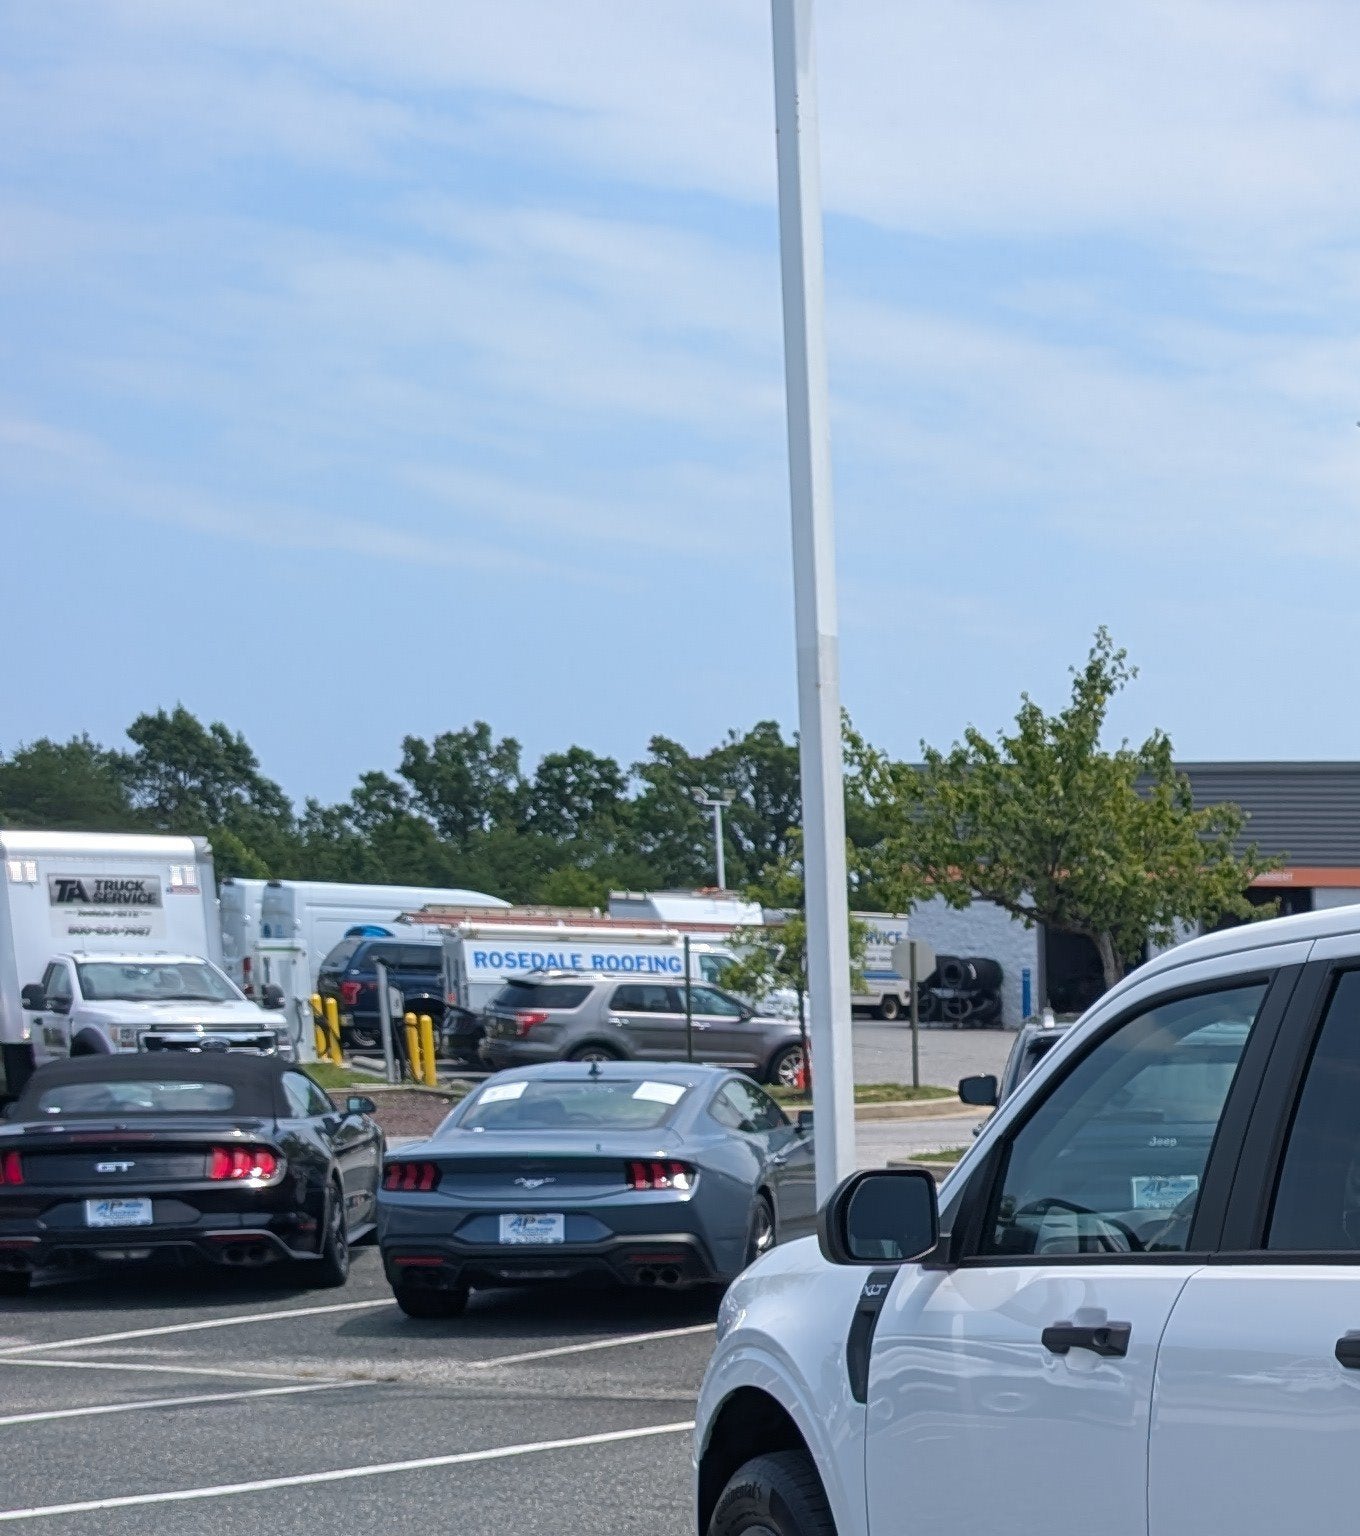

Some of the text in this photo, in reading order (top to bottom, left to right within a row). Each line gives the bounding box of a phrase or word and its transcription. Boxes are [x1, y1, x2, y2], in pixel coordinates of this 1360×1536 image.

[55, 879, 91, 903] TA
[94, 879, 145, 891] TRUCK
[93, 891, 157, 904] SERVICE
[473, 950, 683, 973] ROSEDALE ROOFING
[1148, 1135, 1178, 1147] Jeep
[95, 1161, 136, 1173] GT
[861, 1284, 888, 1297] XLT
